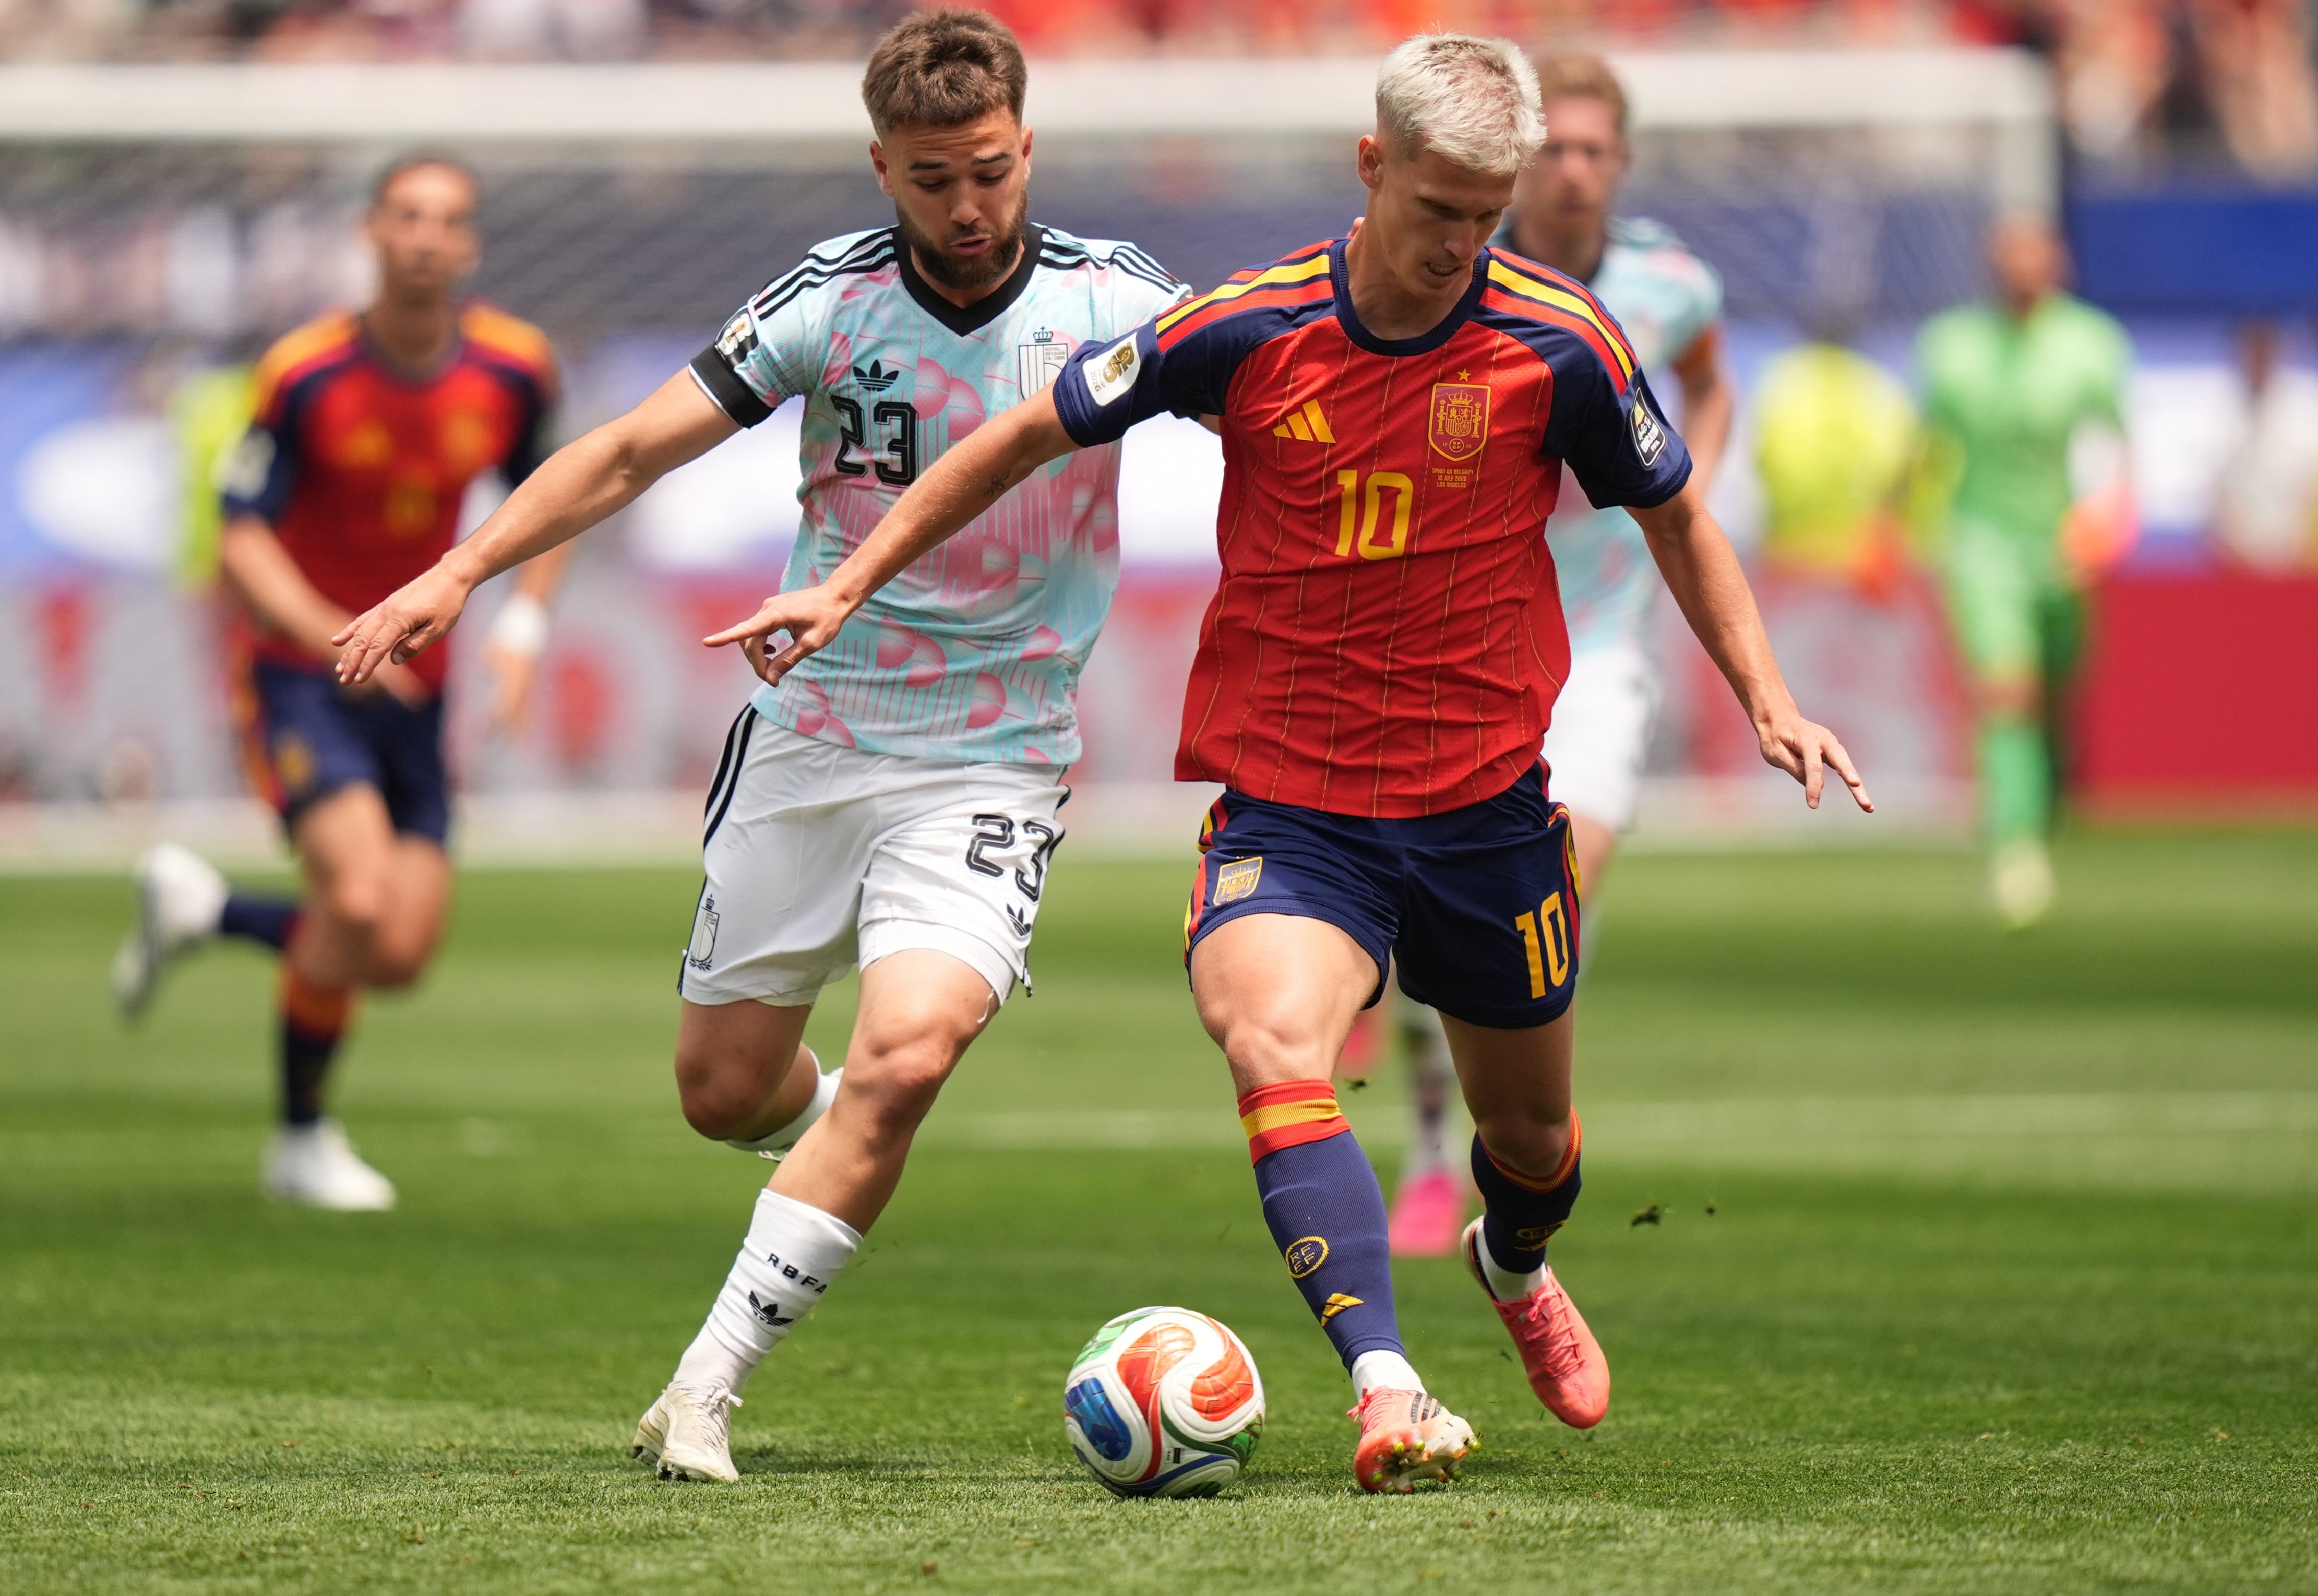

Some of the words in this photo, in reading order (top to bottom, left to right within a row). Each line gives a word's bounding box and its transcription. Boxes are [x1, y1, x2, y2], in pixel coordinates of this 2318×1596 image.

[1090, 371, 1102, 392] 2026
[830, 395, 919, 488] 23
[1650, 440, 1660, 452] FIFA
[1335, 469, 1413, 560] 10
[965, 814, 1054, 904] 23
[1515, 891, 1569, 999] 10
